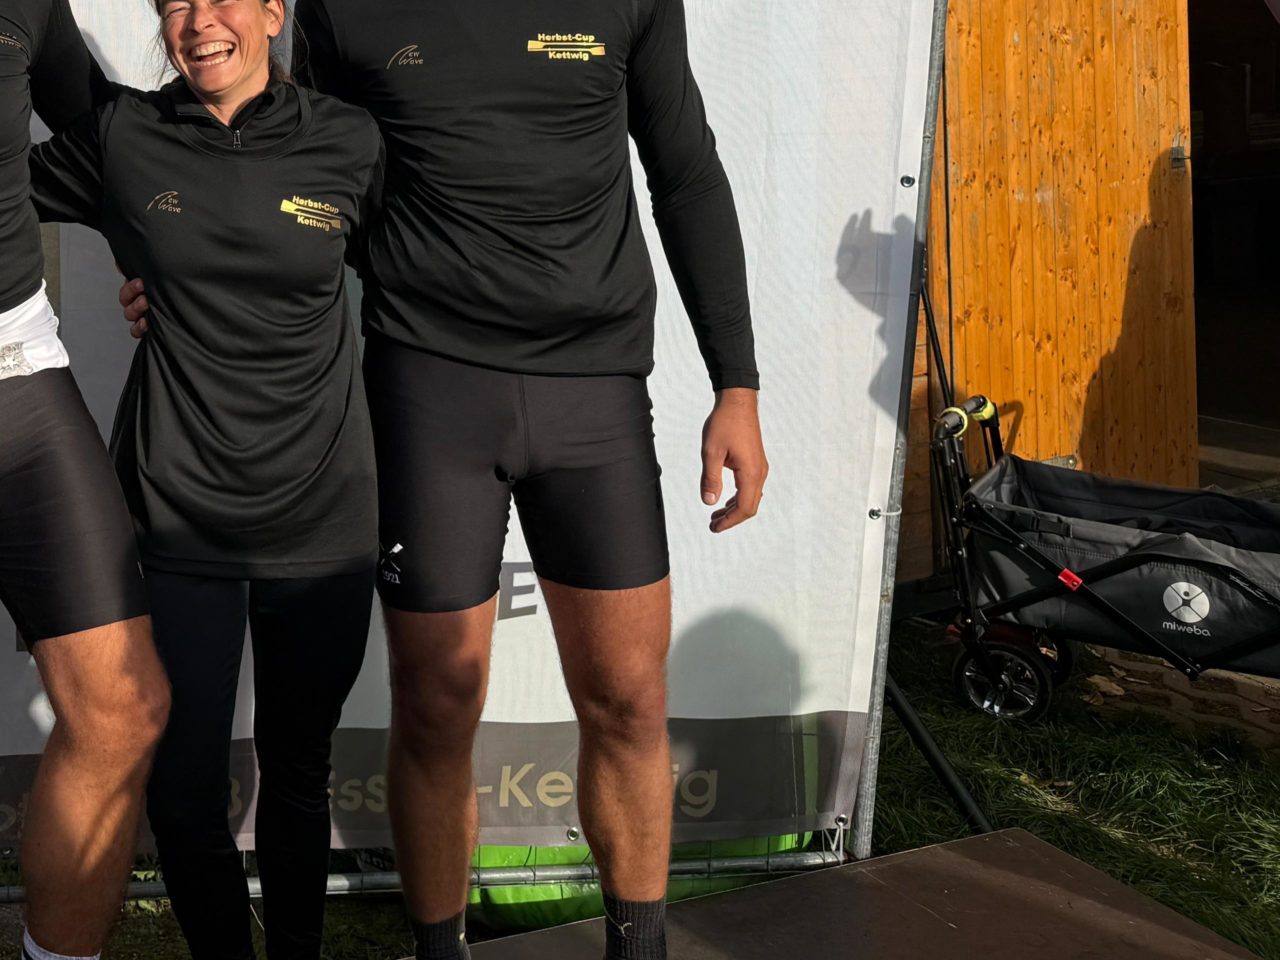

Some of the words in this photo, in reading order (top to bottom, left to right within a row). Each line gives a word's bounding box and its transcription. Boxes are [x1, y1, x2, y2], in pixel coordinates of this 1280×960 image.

[537, 32, 595, 43] Herbst-Cup
[548, 50, 590, 61] Kettwig
[292, 195, 340, 214] Herbst-Cup
[296, 215, 330, 232] Kettwig
[1162, 621, 1212, 638] miweba
